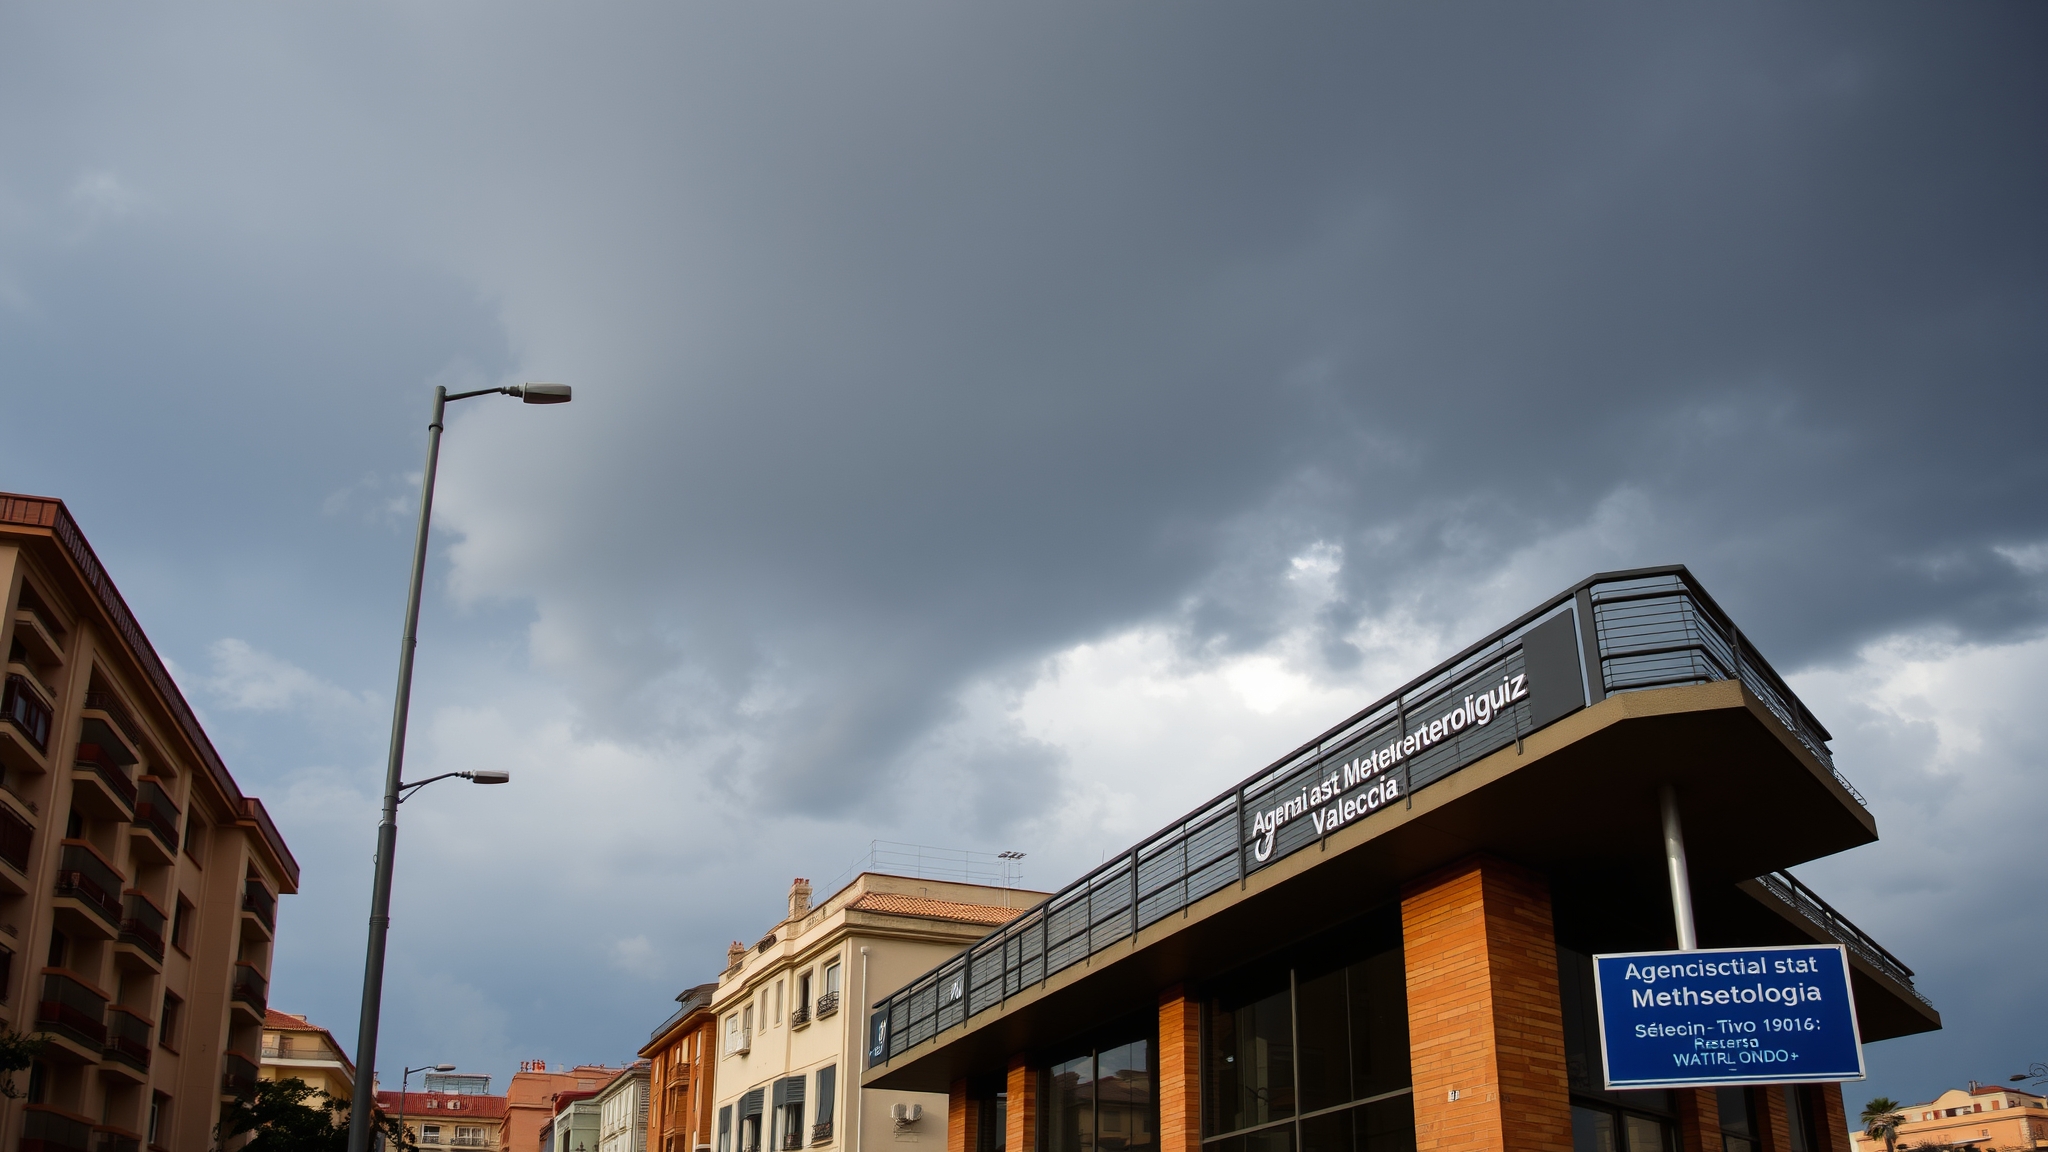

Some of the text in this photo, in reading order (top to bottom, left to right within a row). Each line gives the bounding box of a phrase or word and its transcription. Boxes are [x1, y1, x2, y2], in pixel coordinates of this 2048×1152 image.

[1311, 775, 1400, 835] Valeccia
[1774, 956, 1819, 974] stat
[1631, 982, 1822, 1009] Methsetologia
